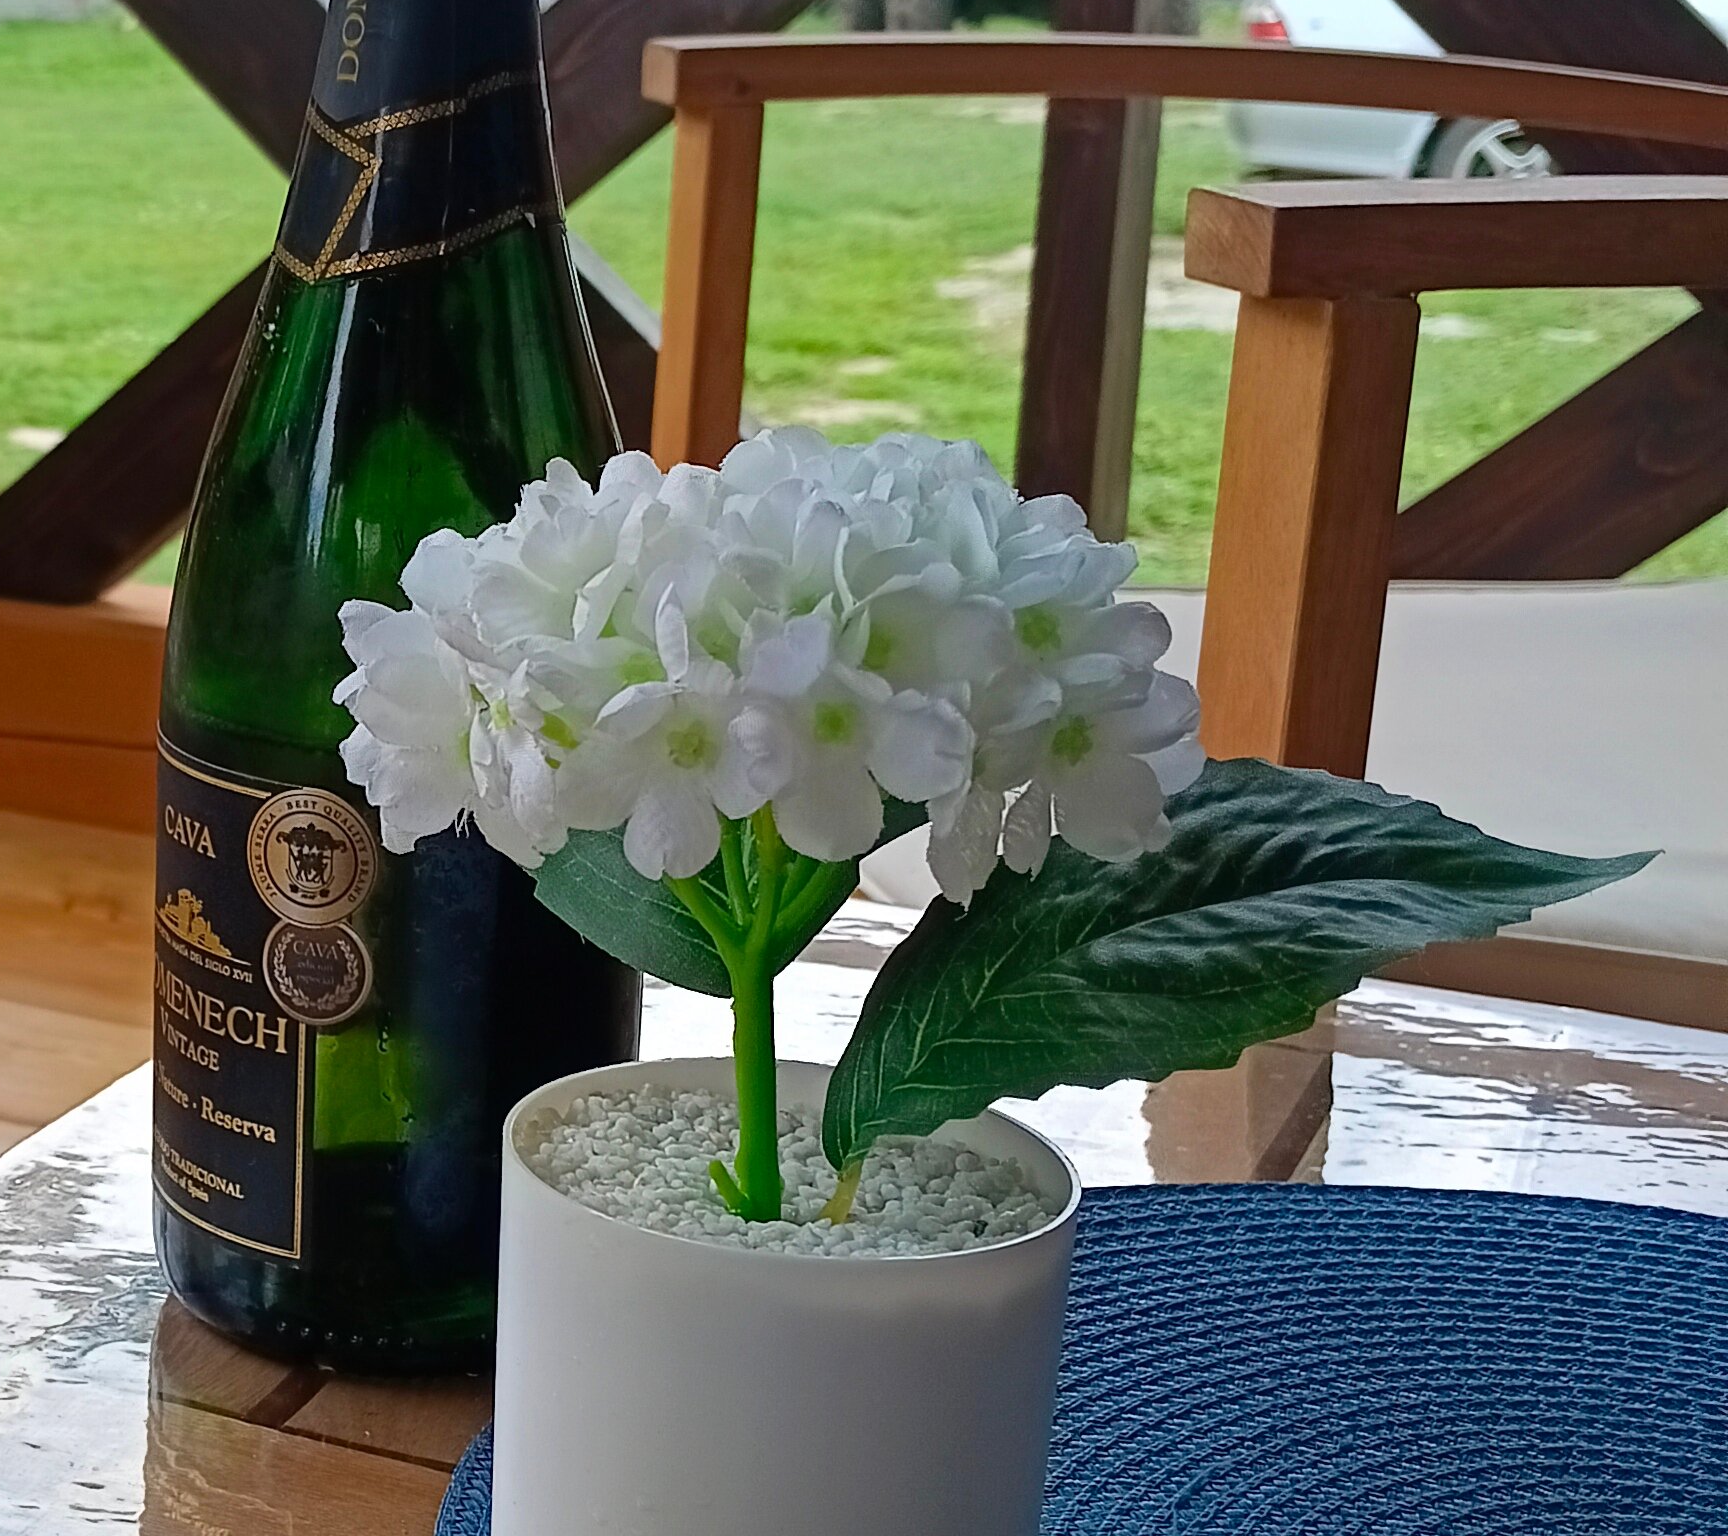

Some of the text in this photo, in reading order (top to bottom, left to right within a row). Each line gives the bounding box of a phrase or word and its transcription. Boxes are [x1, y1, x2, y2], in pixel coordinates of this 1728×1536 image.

[164, 804, 217, 859] CAVA
[254, 812, 277, 848] SERRA
[286, 799, 370, 904] BEST QUALITY BRAND
[189, 949, 204, 966] DEL
[204, 957, 231, 976] SIGLO
[232, 967, 253, 984] XVII
[293, 940, 339, 961] CAVA
[154, 953, 288, 1054] MENECH
[160, 1005, 220, 1072] VINTAGE
[201, 1095, 277, 1143] Reserva
[170, 1148, 245, 1199] TRADICIONAL
